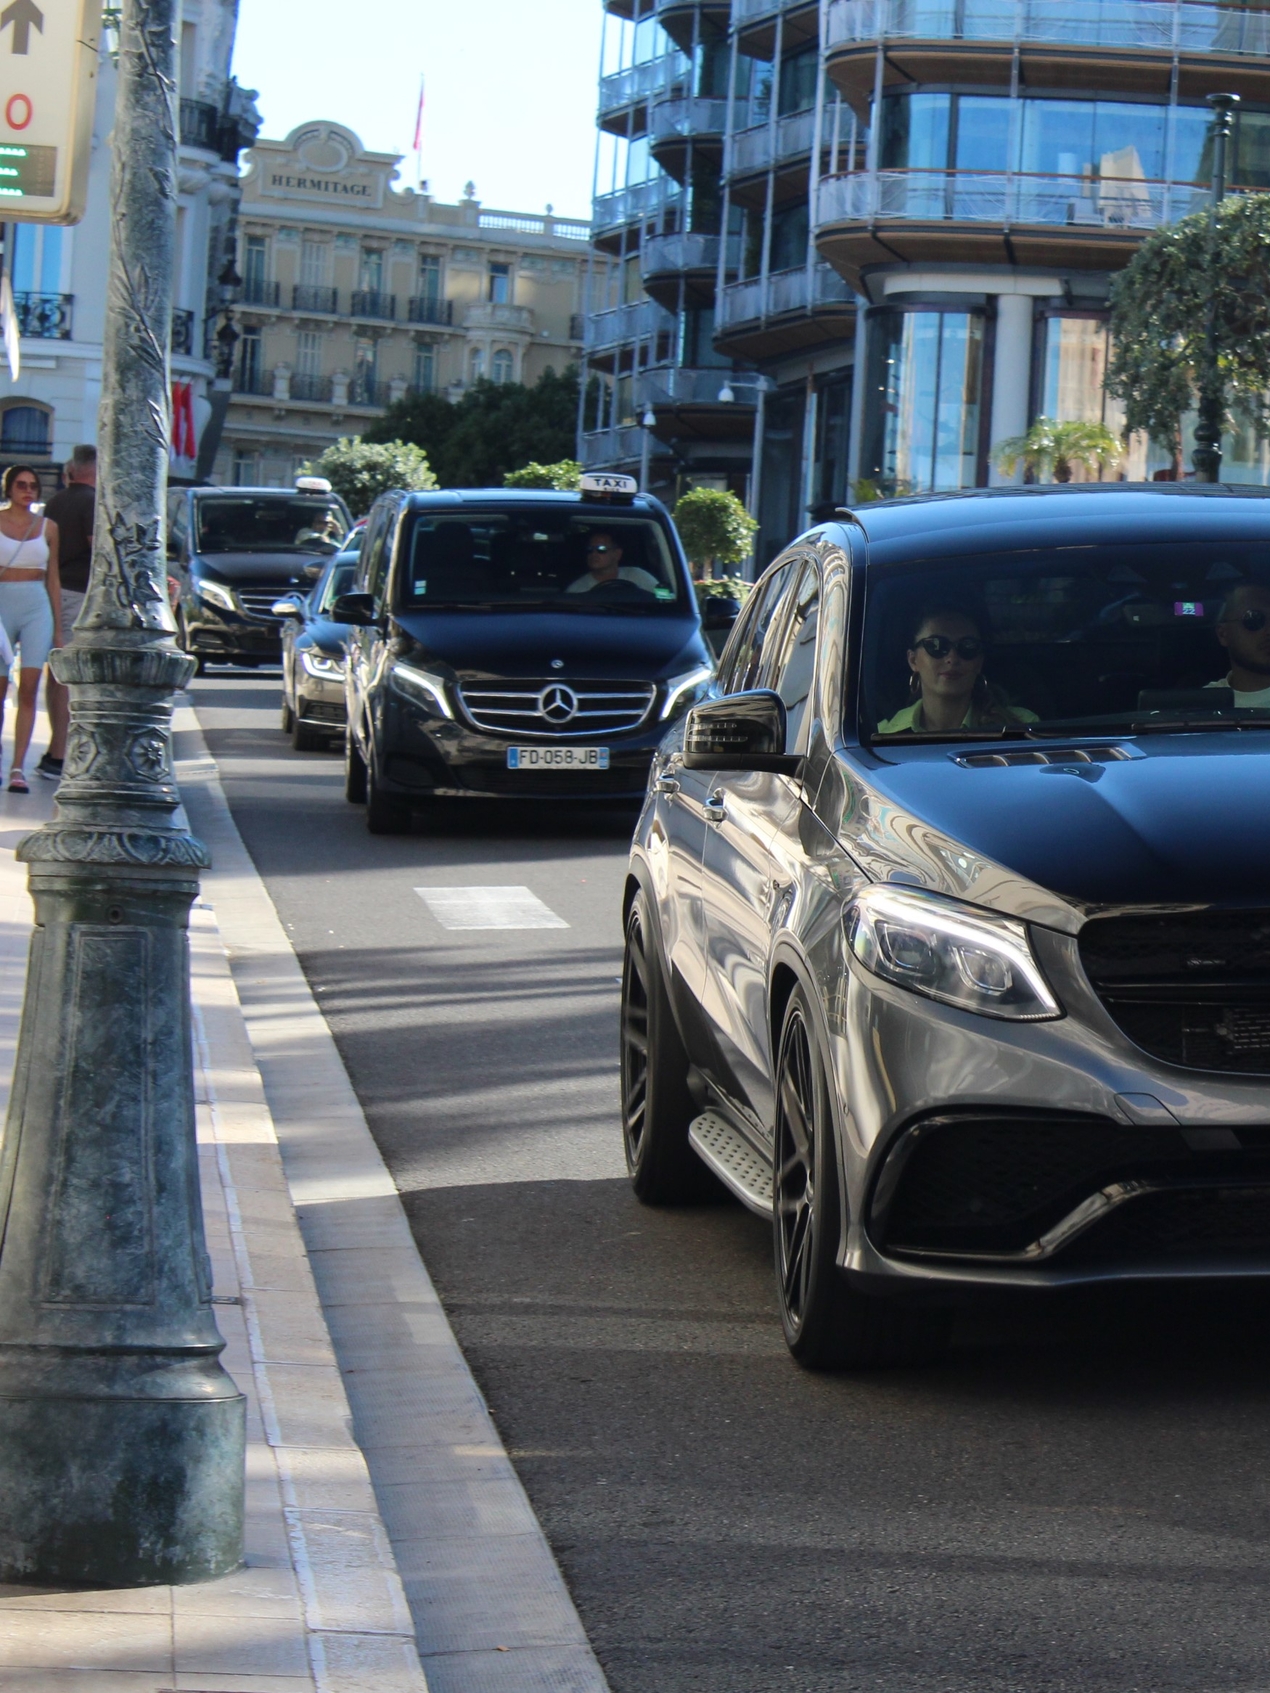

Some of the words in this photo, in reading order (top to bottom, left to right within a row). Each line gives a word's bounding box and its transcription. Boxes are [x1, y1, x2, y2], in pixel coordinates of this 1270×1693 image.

[271, 174, 372, 197] HERMITAGE
[594, 479, 627, 488] TAXI
[519, 750, 598, 764] FD-058-JB
